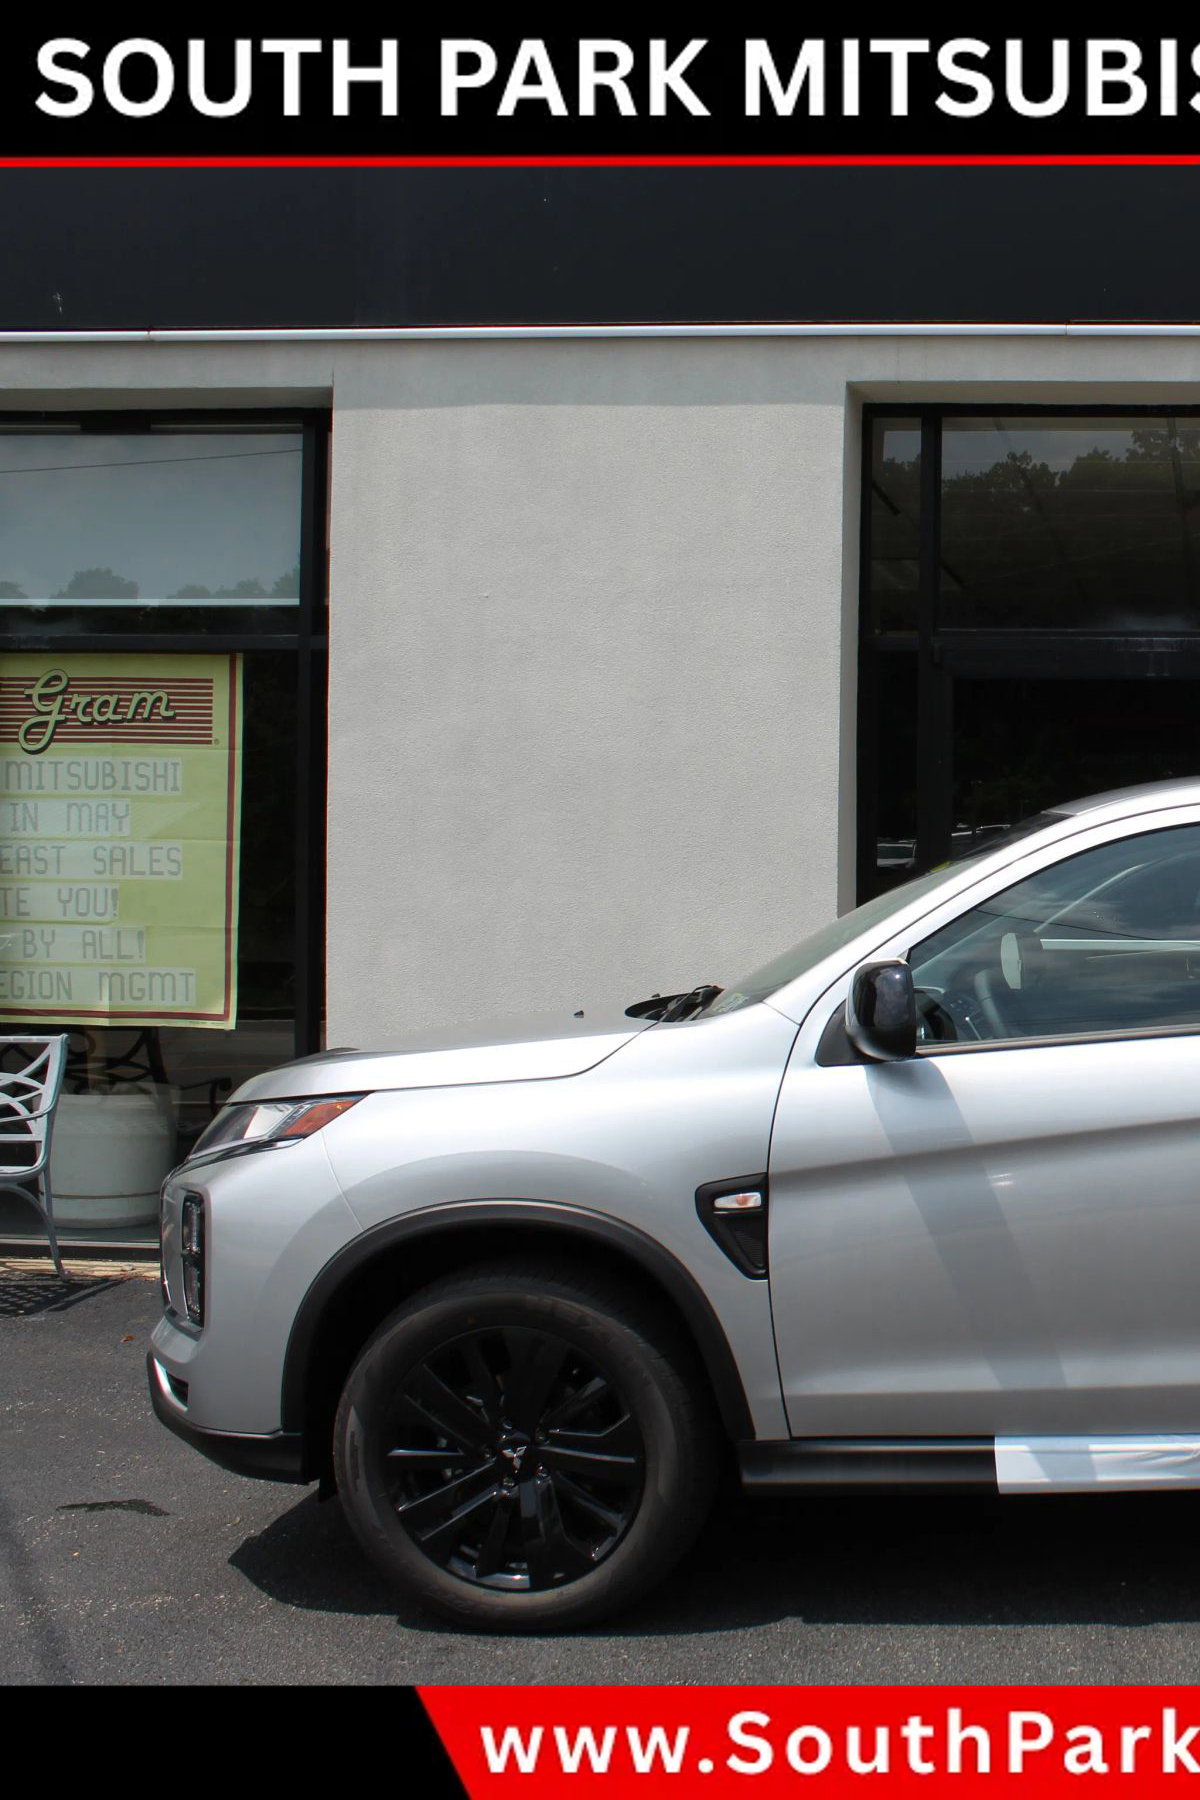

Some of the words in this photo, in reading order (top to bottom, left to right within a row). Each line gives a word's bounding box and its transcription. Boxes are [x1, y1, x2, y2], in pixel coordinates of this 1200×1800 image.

[18, 669, 176, 755] Gram
[5, 760, 181, 793] MITSUBISHI
[10, 802, 39, 832] IN
[66, 802, 130, 833] MAY
[93, 846, 182, 877] SALES
[58, 887, 119, 918] YOU!
[22, 928, 56, 959] BY
[82, 929, 146, 960] ALL!
[98, 970, 195, 1003] MGMT
